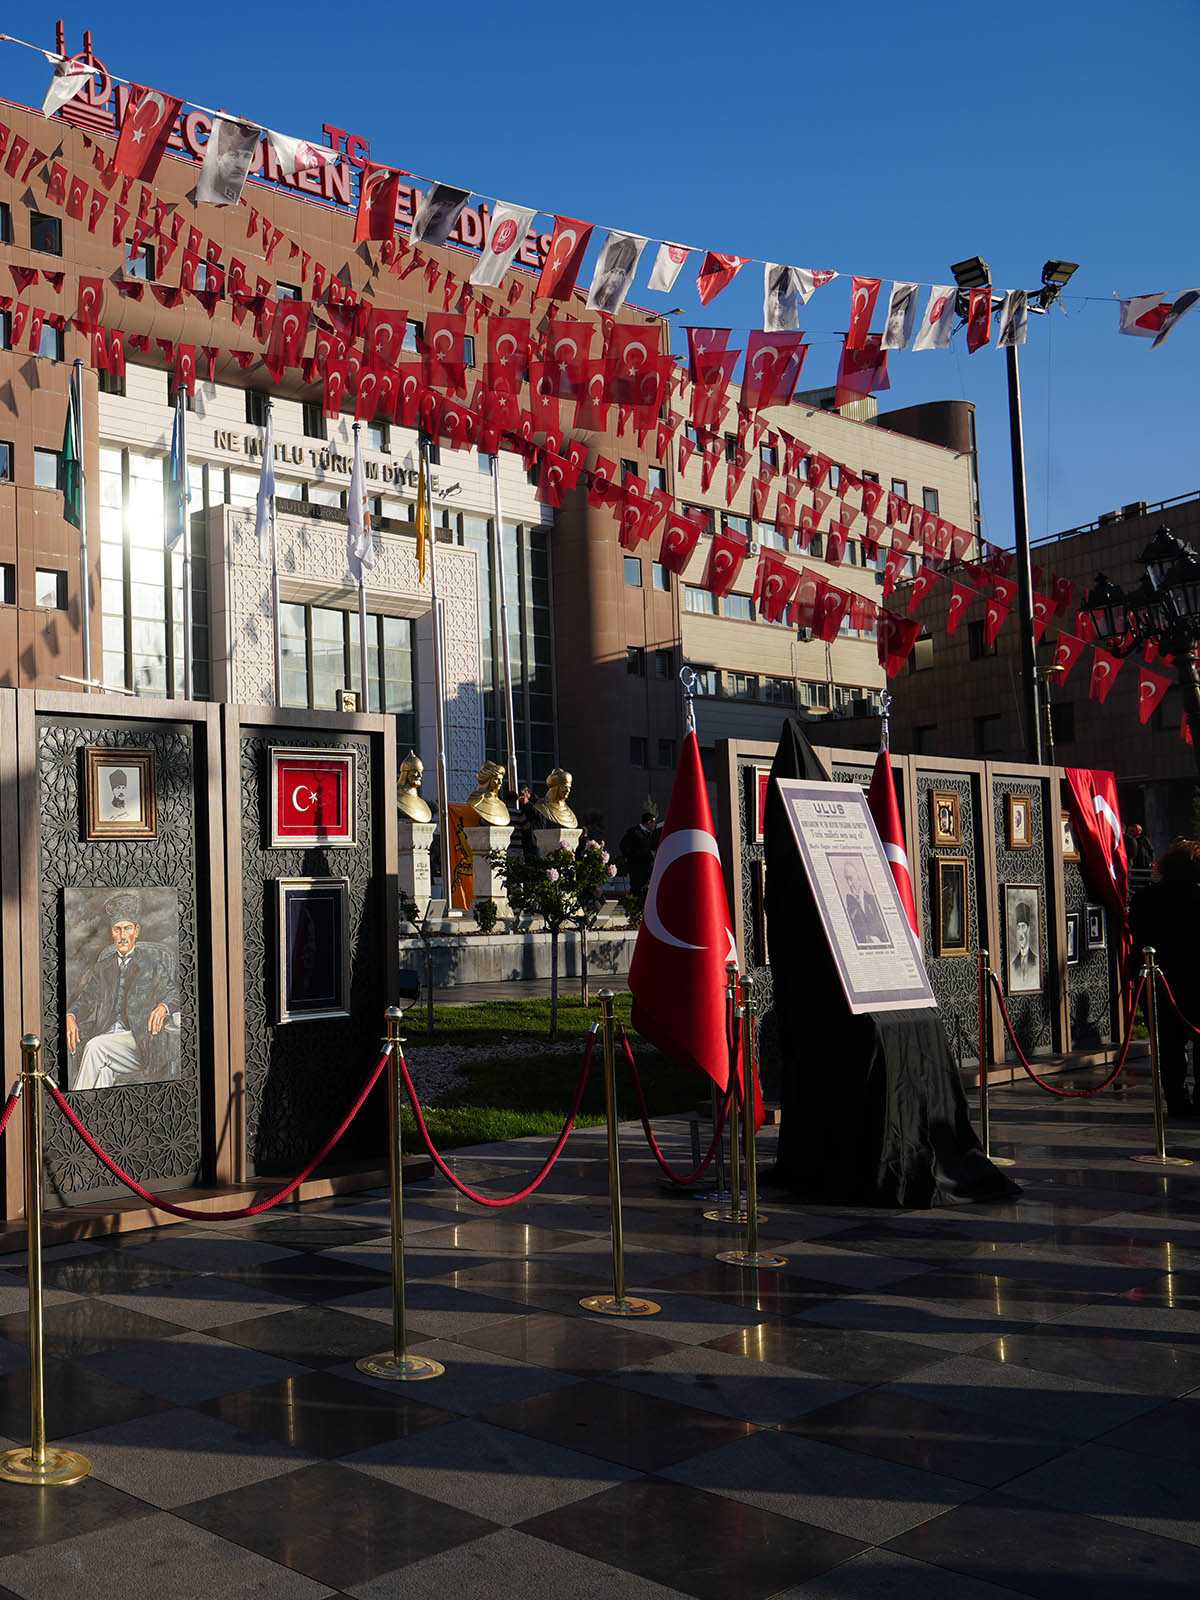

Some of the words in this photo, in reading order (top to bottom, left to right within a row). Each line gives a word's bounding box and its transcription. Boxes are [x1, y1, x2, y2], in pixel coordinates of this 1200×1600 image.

[214, 429, 240, 452] NE
[309, 446, 379, 481] TÜRKM
[383, 461, 440, 493] DİYEE
[812, 803, 845, 815] ULUS
